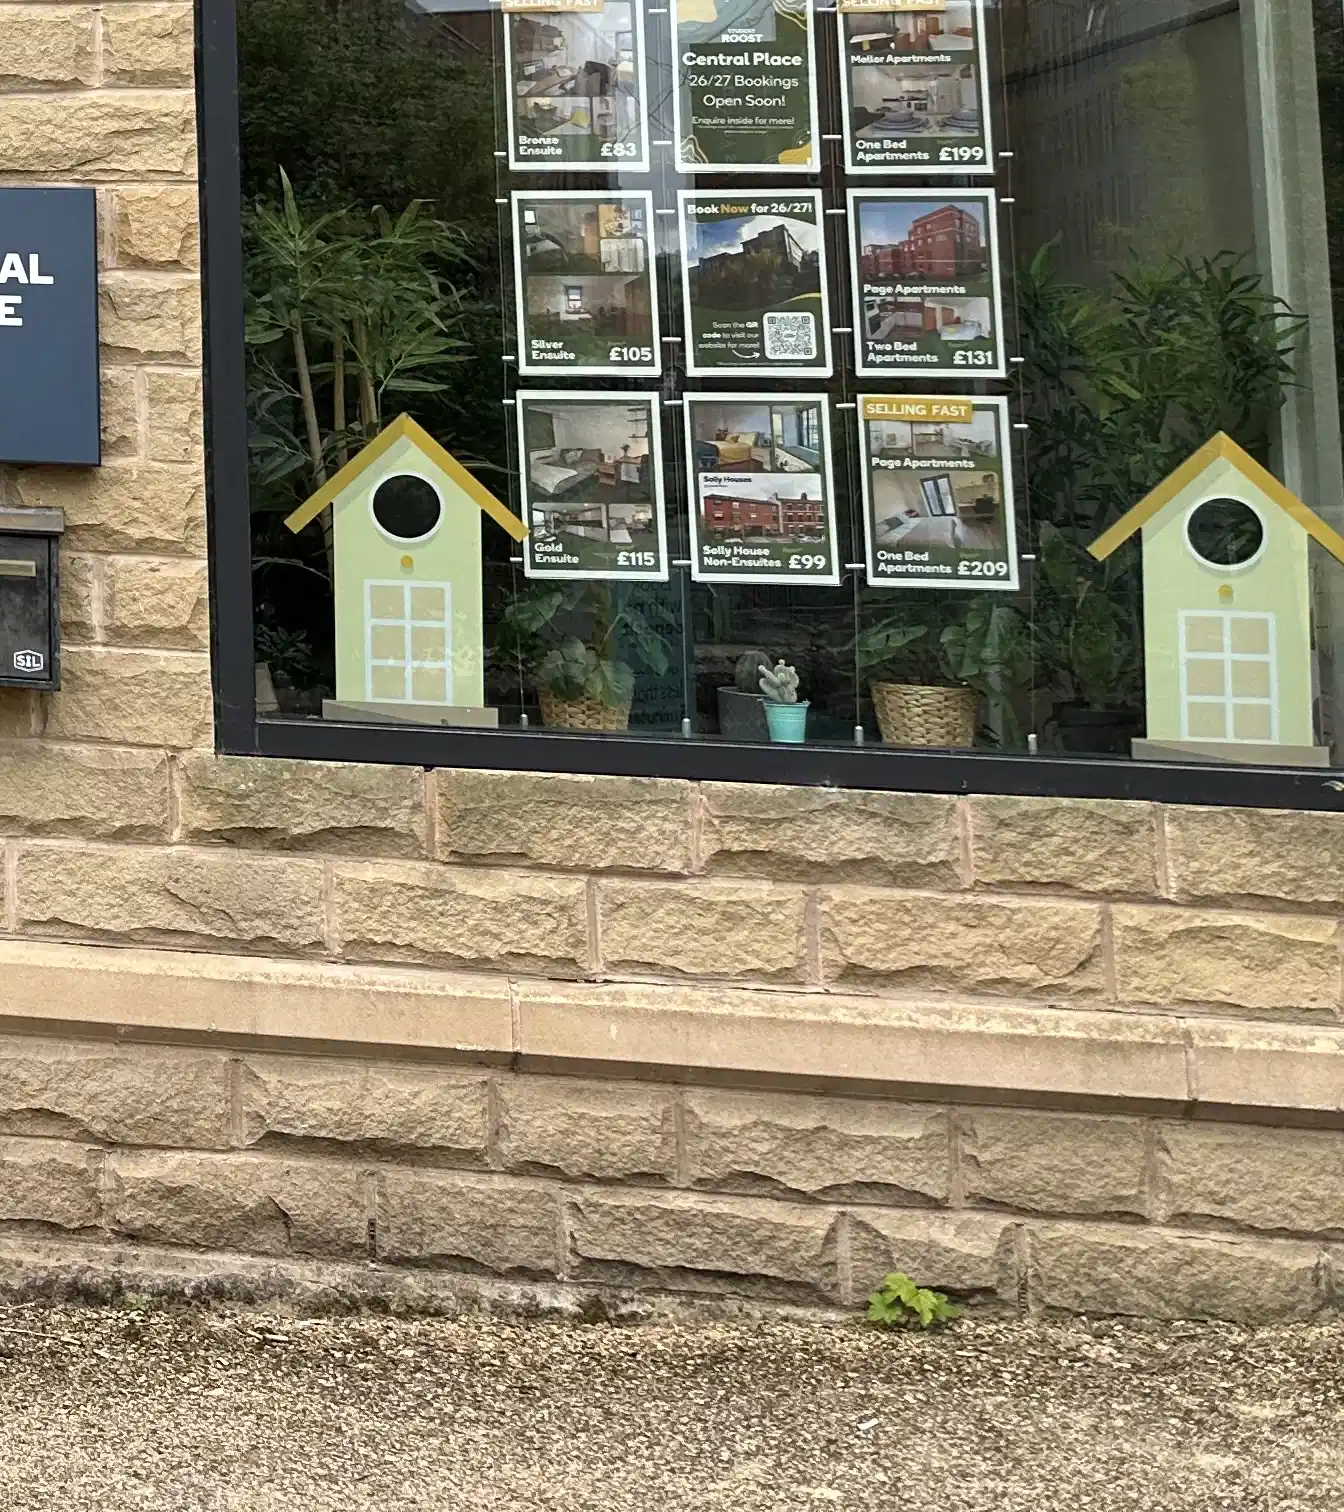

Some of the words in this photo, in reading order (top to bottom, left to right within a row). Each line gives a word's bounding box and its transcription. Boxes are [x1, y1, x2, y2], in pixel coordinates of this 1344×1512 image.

[721, 33, 763, 43] ROOST
[682, 52, 750, 66] Central
[753, 52, 803, 66] Place
[886, 54, 952, 66] Apartments
[689, 75, 732, 87] 26/27
[734, 75, 799, 89] Bookings
[703, 94, 742, 108] Open
[745, 94, 786, 107] Soon!
[692, 116, 726, 125] Enquire
[727, 116, 753, 125] inside
[755, 116, 767, 125] for
[768, 116, 795, 125] more!
[518, 136, 559, 145] Bronze
[855, 140, 881, 149] One
[883, 139, 907, 149] Bed
[519, 145, 562, 155] Ensuite
[600, 142, 636, 157] £83
[939, 146, 984, 161] £199
[856, 151, 929, 162] Apartments
[687, 203, 719, 214] Book
[720, 203, 749, 213] Now
[750, 202, 768, 213] for
[770, 202, 813, 213] 26/27!
[863, 284, 893, 295] Page
[895, 284, 966, 295] Apartments
[531, 339, 564, 349] Silver
[866, 341, 892, 351] Two
[893, 341, 917, 351] Bed
[532, 350, 576, 360] Ensuite
[609, 347, 652, 361] £105
[867, 353, 939, 364] Apartments
[953, 350, 993, 365] £131
[866, 404, 926, 416] SELLING
[931, 405, 968, 417] FAST
[871, 457, 901, 469] Page
[903, 457, 975, 469] Apartments
[534, 543, 563, 552] Gold
[702, 546, 731, 557] Solly
[733, 546, 770, 556] House
[535, 554, 579, 564] Ensuite
[617, 551, 655, 566] £115
[877, 550, 903, 561] One
[905, 551, 929, 561] Bed
[703, 556, 782, 567] Non-Ensuites
[788, 554, 826, 569] £99
[877, 563, 952, 574] Apartments
[957, 561, 1008, 576] £209
[16, 655, 41, 668] SIL
